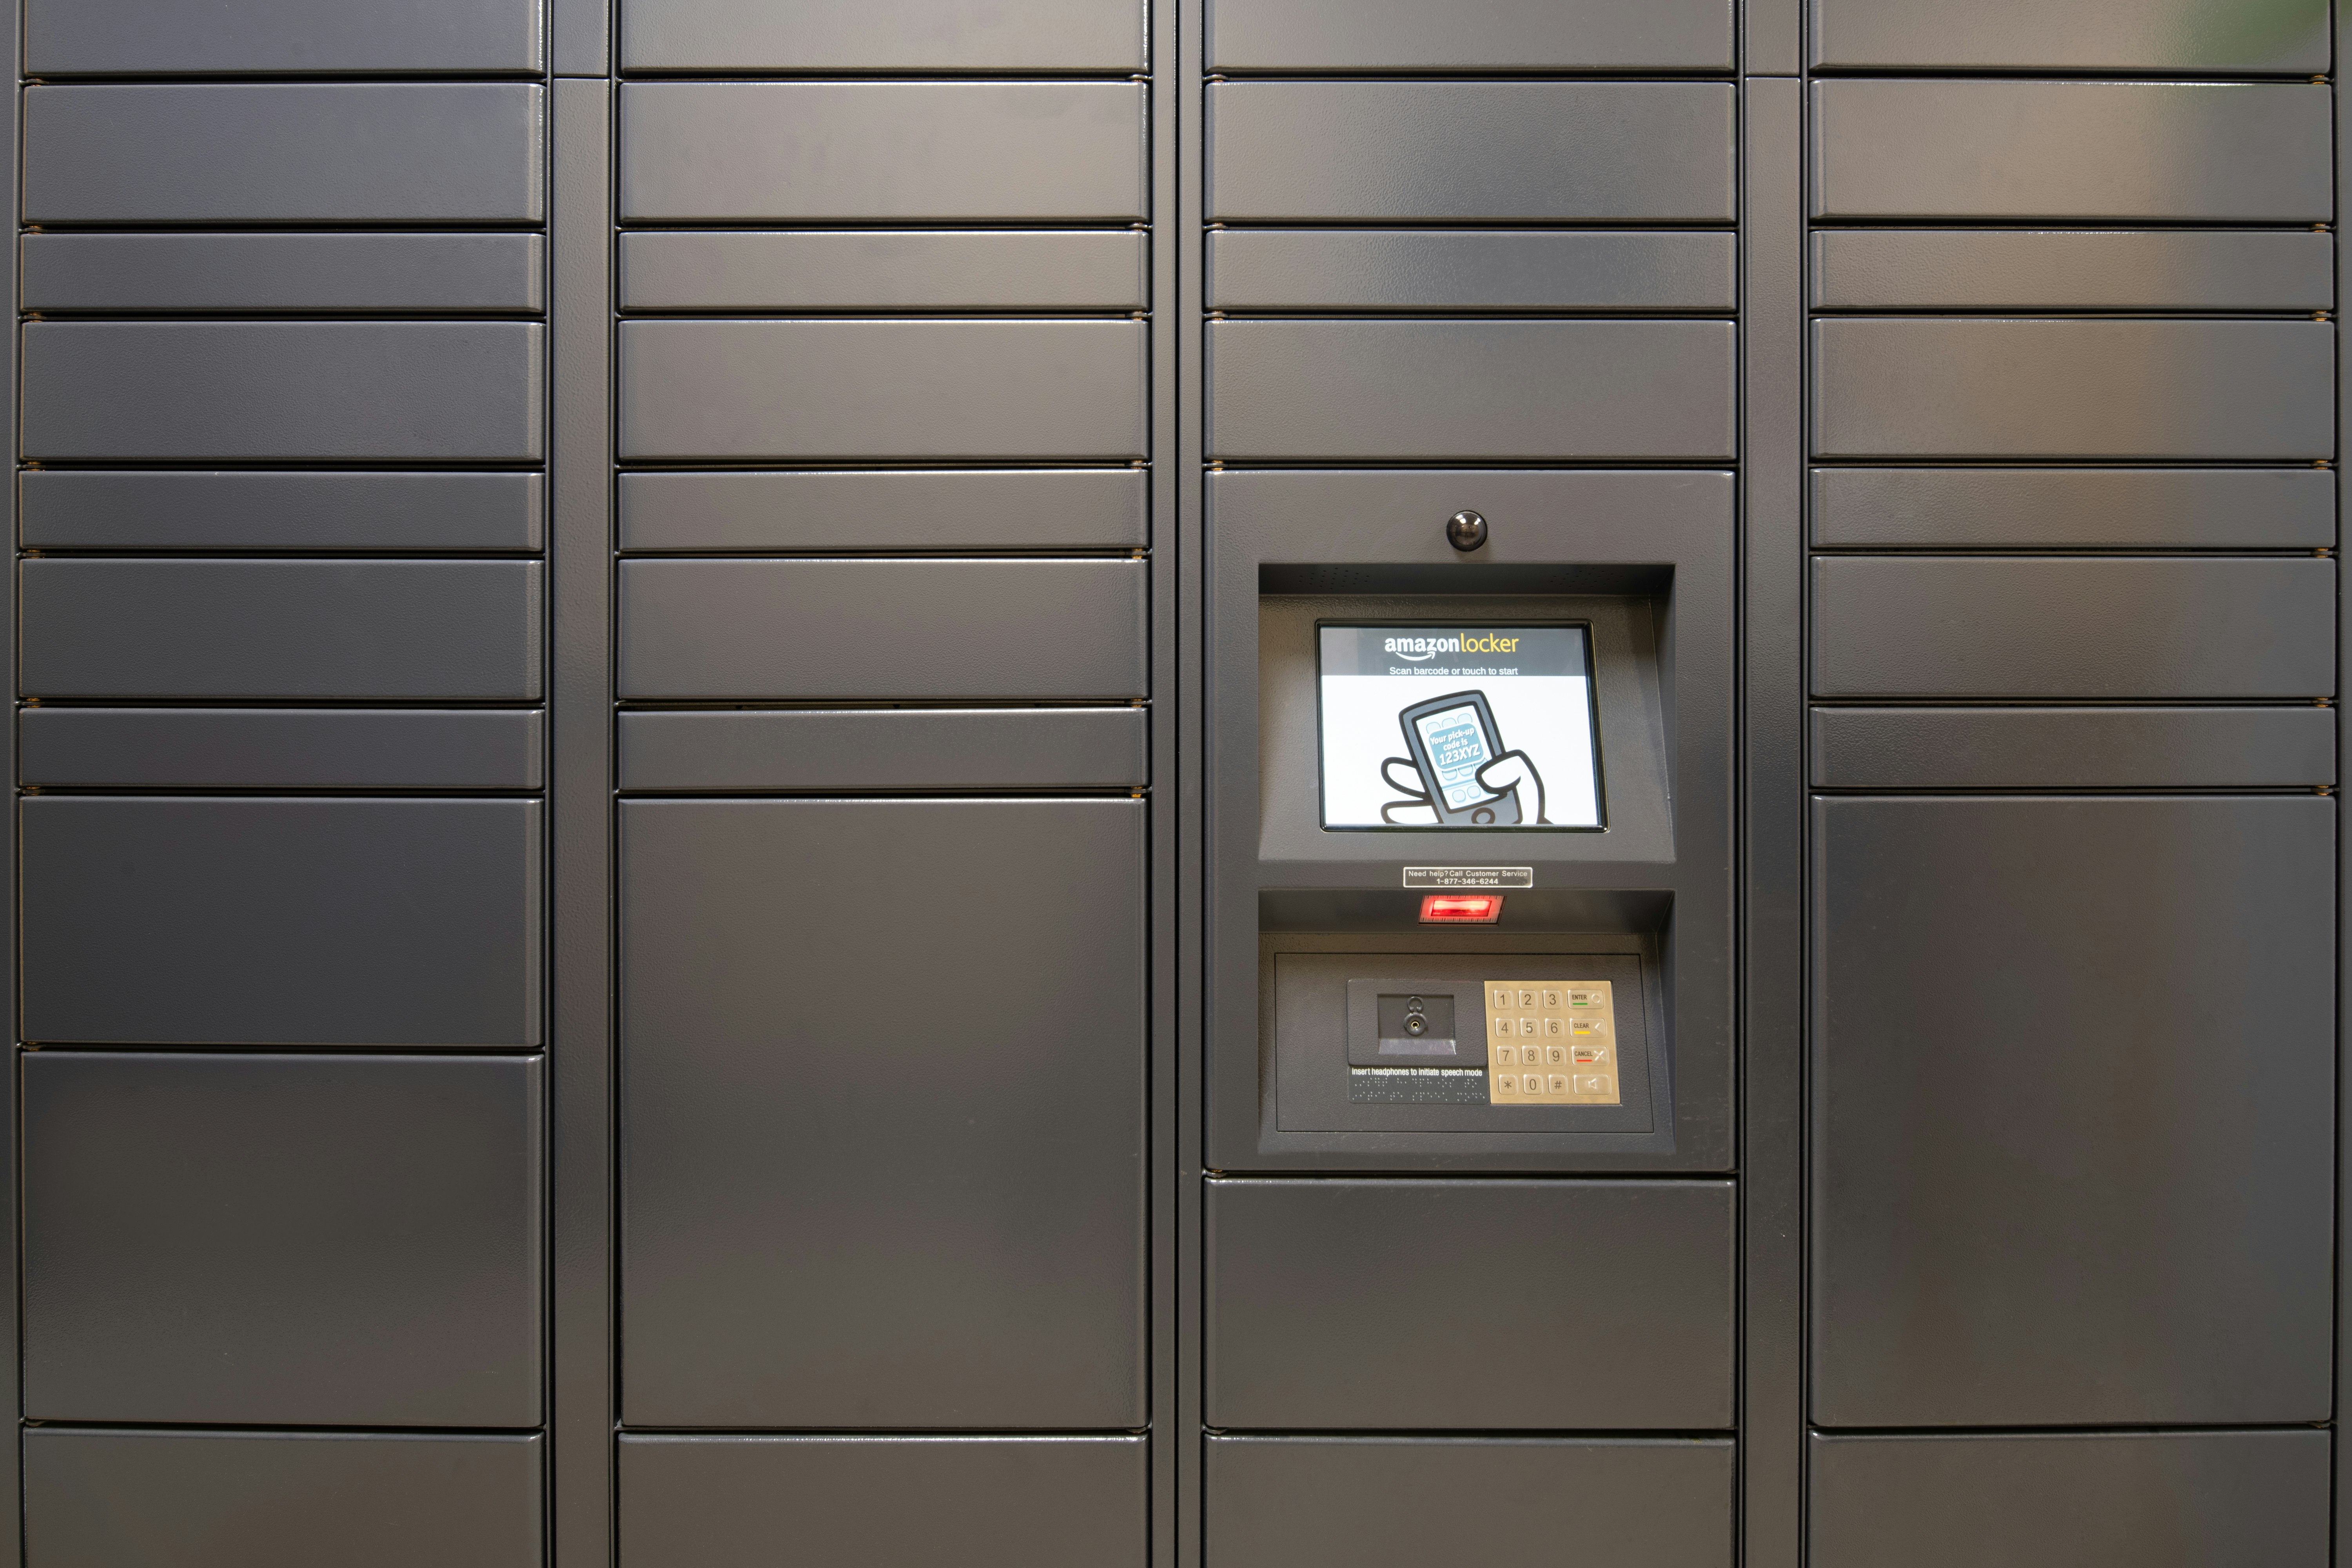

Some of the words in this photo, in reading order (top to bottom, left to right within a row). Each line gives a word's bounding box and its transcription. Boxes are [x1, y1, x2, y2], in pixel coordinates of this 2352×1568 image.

[1385, 633, 1519, 652] amazonlocker
[1430, 735, 1447, 745] Your
[1448, 728, 1474, 742] pick-up
[1443, 740, 1461, 751] code
[1461, 738, 1468, 746] is
[1439, 743, 1481, 766] 123XYZ
[1500, 995, 1505, 1005] 1
[1524, 994, 1532, 1005] 2
[1549, 994, 1556, 1005] 3
[1501, 1022, 1508, 1033] 4
[1526, 1022, 1533, 1033] 5
[1550, 1022, 1558, 1033] 6
[1502, 1050, 1509, 1061] 7
[1528, 1050, 1535, 1061] 8
[1552, 1050, 1560, 1062] 9
[1372, 1068, 1409, 1076] headphones
[1441, 1068, 1463, 1077] speech
[1529, 1079, 1536, 1090] 0
